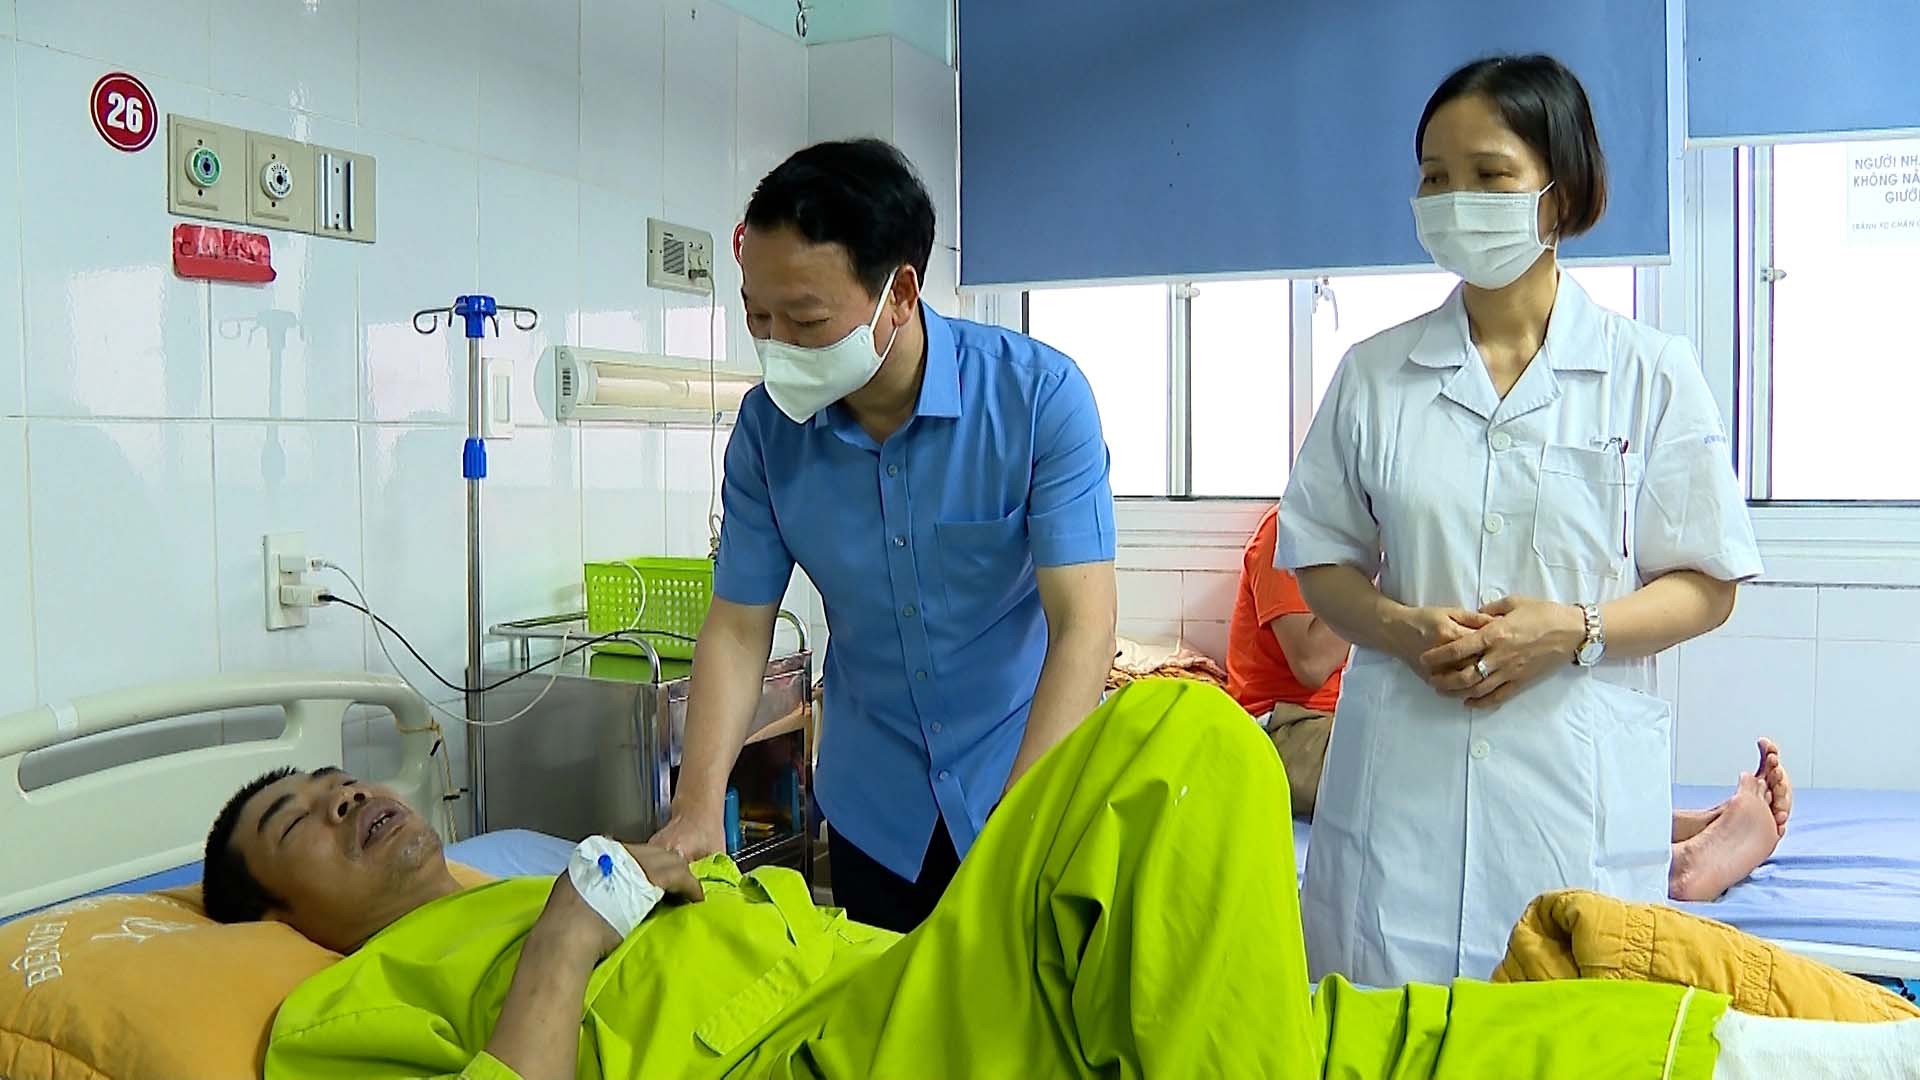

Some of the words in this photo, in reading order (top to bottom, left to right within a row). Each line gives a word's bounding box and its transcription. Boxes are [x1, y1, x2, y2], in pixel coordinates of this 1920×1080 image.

[107, 92, 143, 134] 26
[1902, 155, 1920, 167] NH
[1854, 172, 1898, 187] KHÔNG
